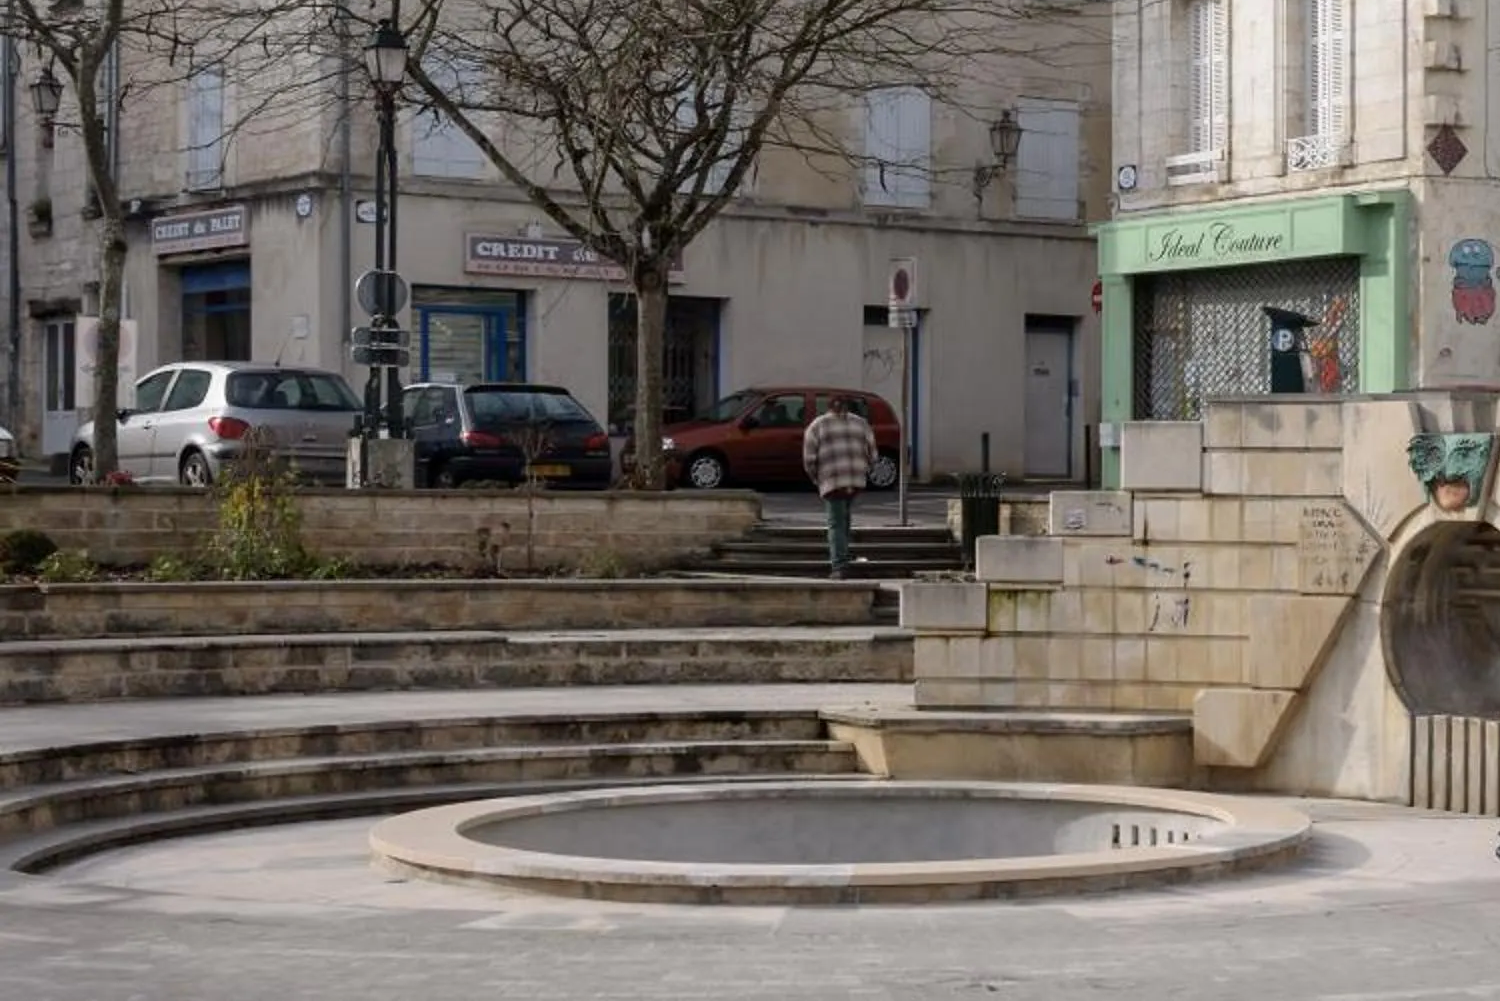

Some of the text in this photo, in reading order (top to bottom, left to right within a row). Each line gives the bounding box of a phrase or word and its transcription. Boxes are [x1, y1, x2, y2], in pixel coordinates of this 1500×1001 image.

[476, 241, 559, 261] CREDIT
[1149, 221, 1284, 262] Ideal Couture
